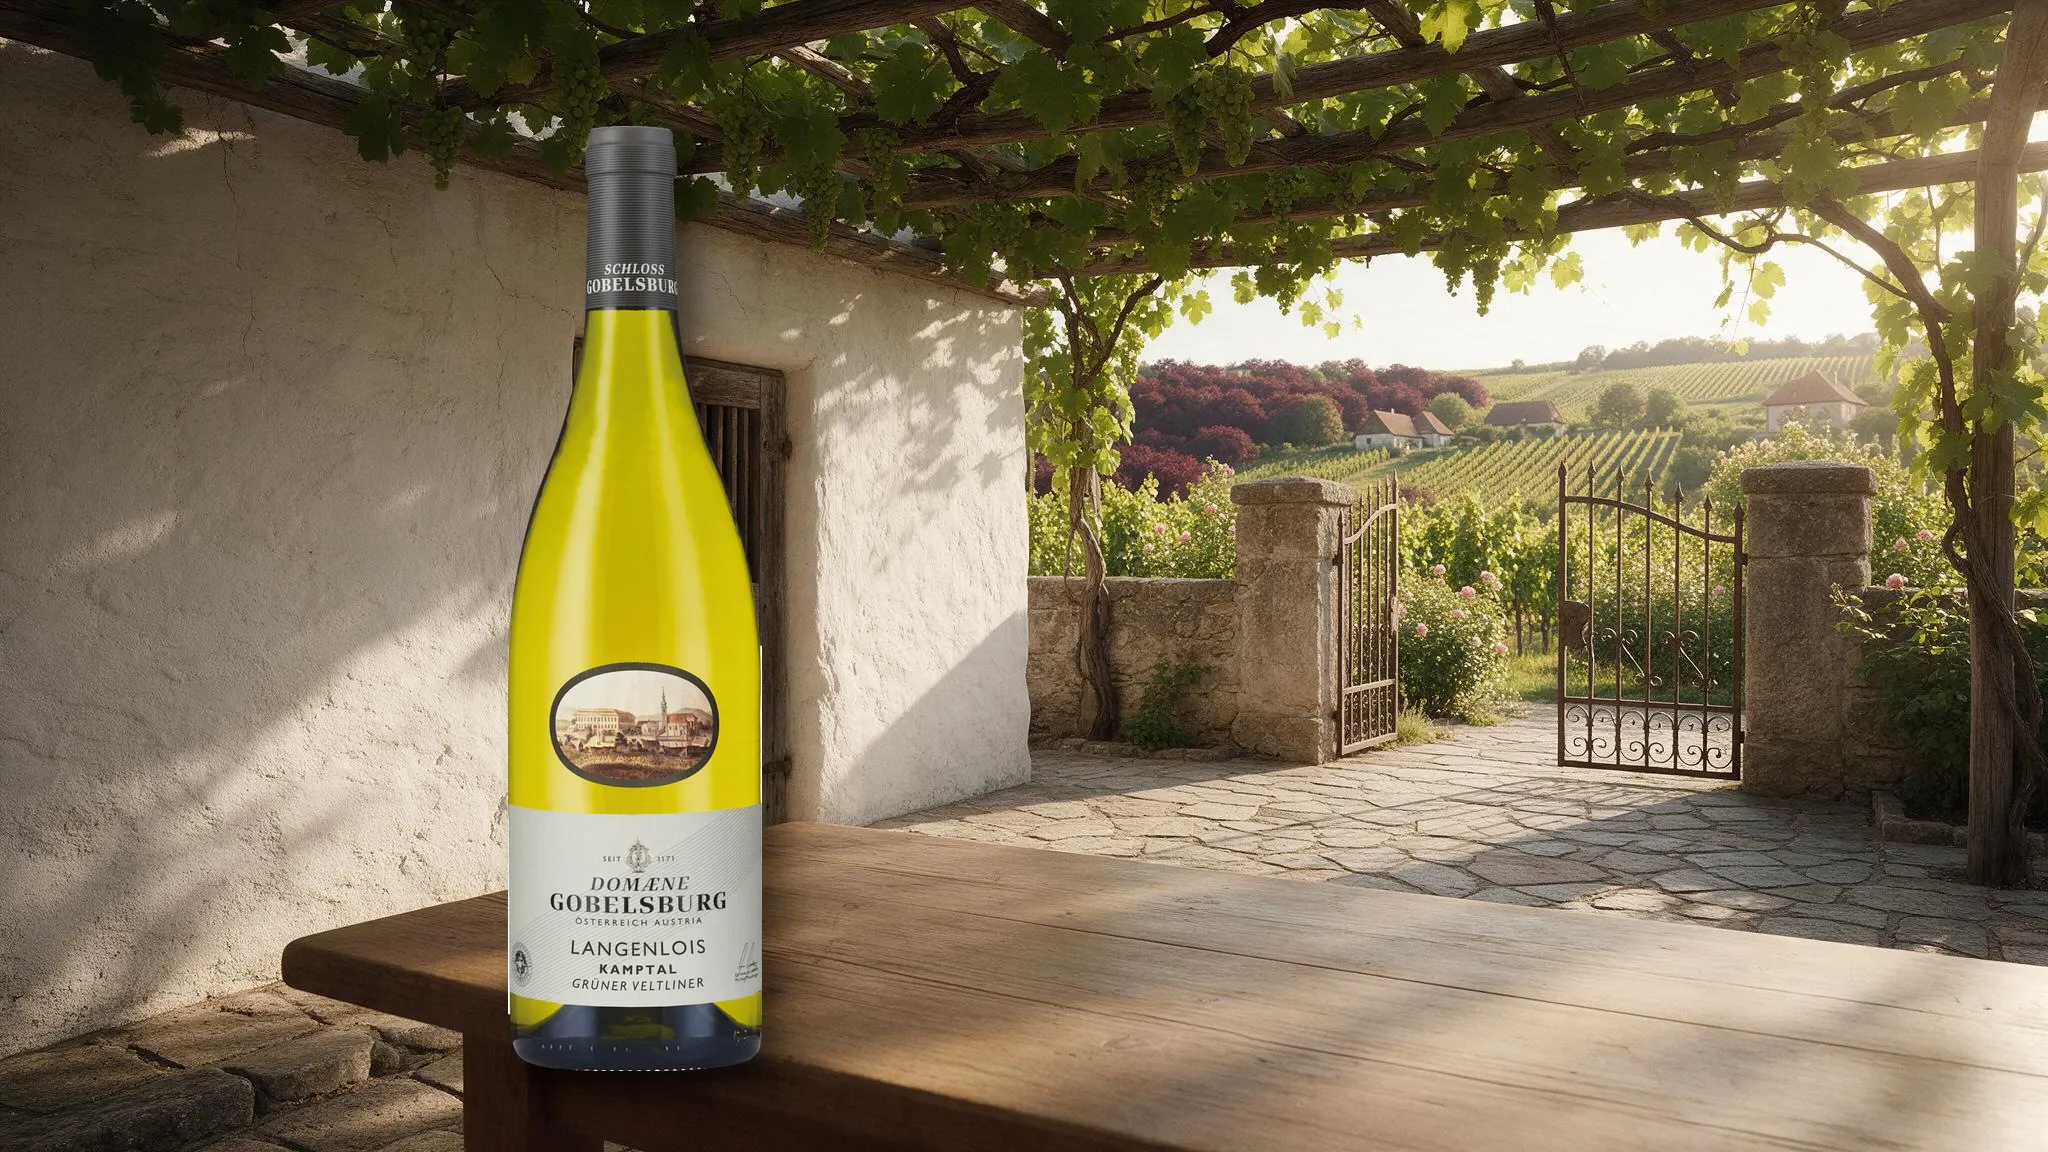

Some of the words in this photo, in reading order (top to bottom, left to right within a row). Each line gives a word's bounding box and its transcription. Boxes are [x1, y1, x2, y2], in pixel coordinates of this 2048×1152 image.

[604, 263, 665, 275] SCHLOSS
[590, 876, 690, 891] DOMÆNE
[550, 891, 726, 915] GOBELSBURG
[654, 916, 703, 926] AUSTRIA
[571, 939, 706, 957] LANGENLOIS
[599, 963, 677, 975] KAMPTAL
[572, 977, 627, 991] GRÜNER
[632, 977, 704, 991] VELTLINER
